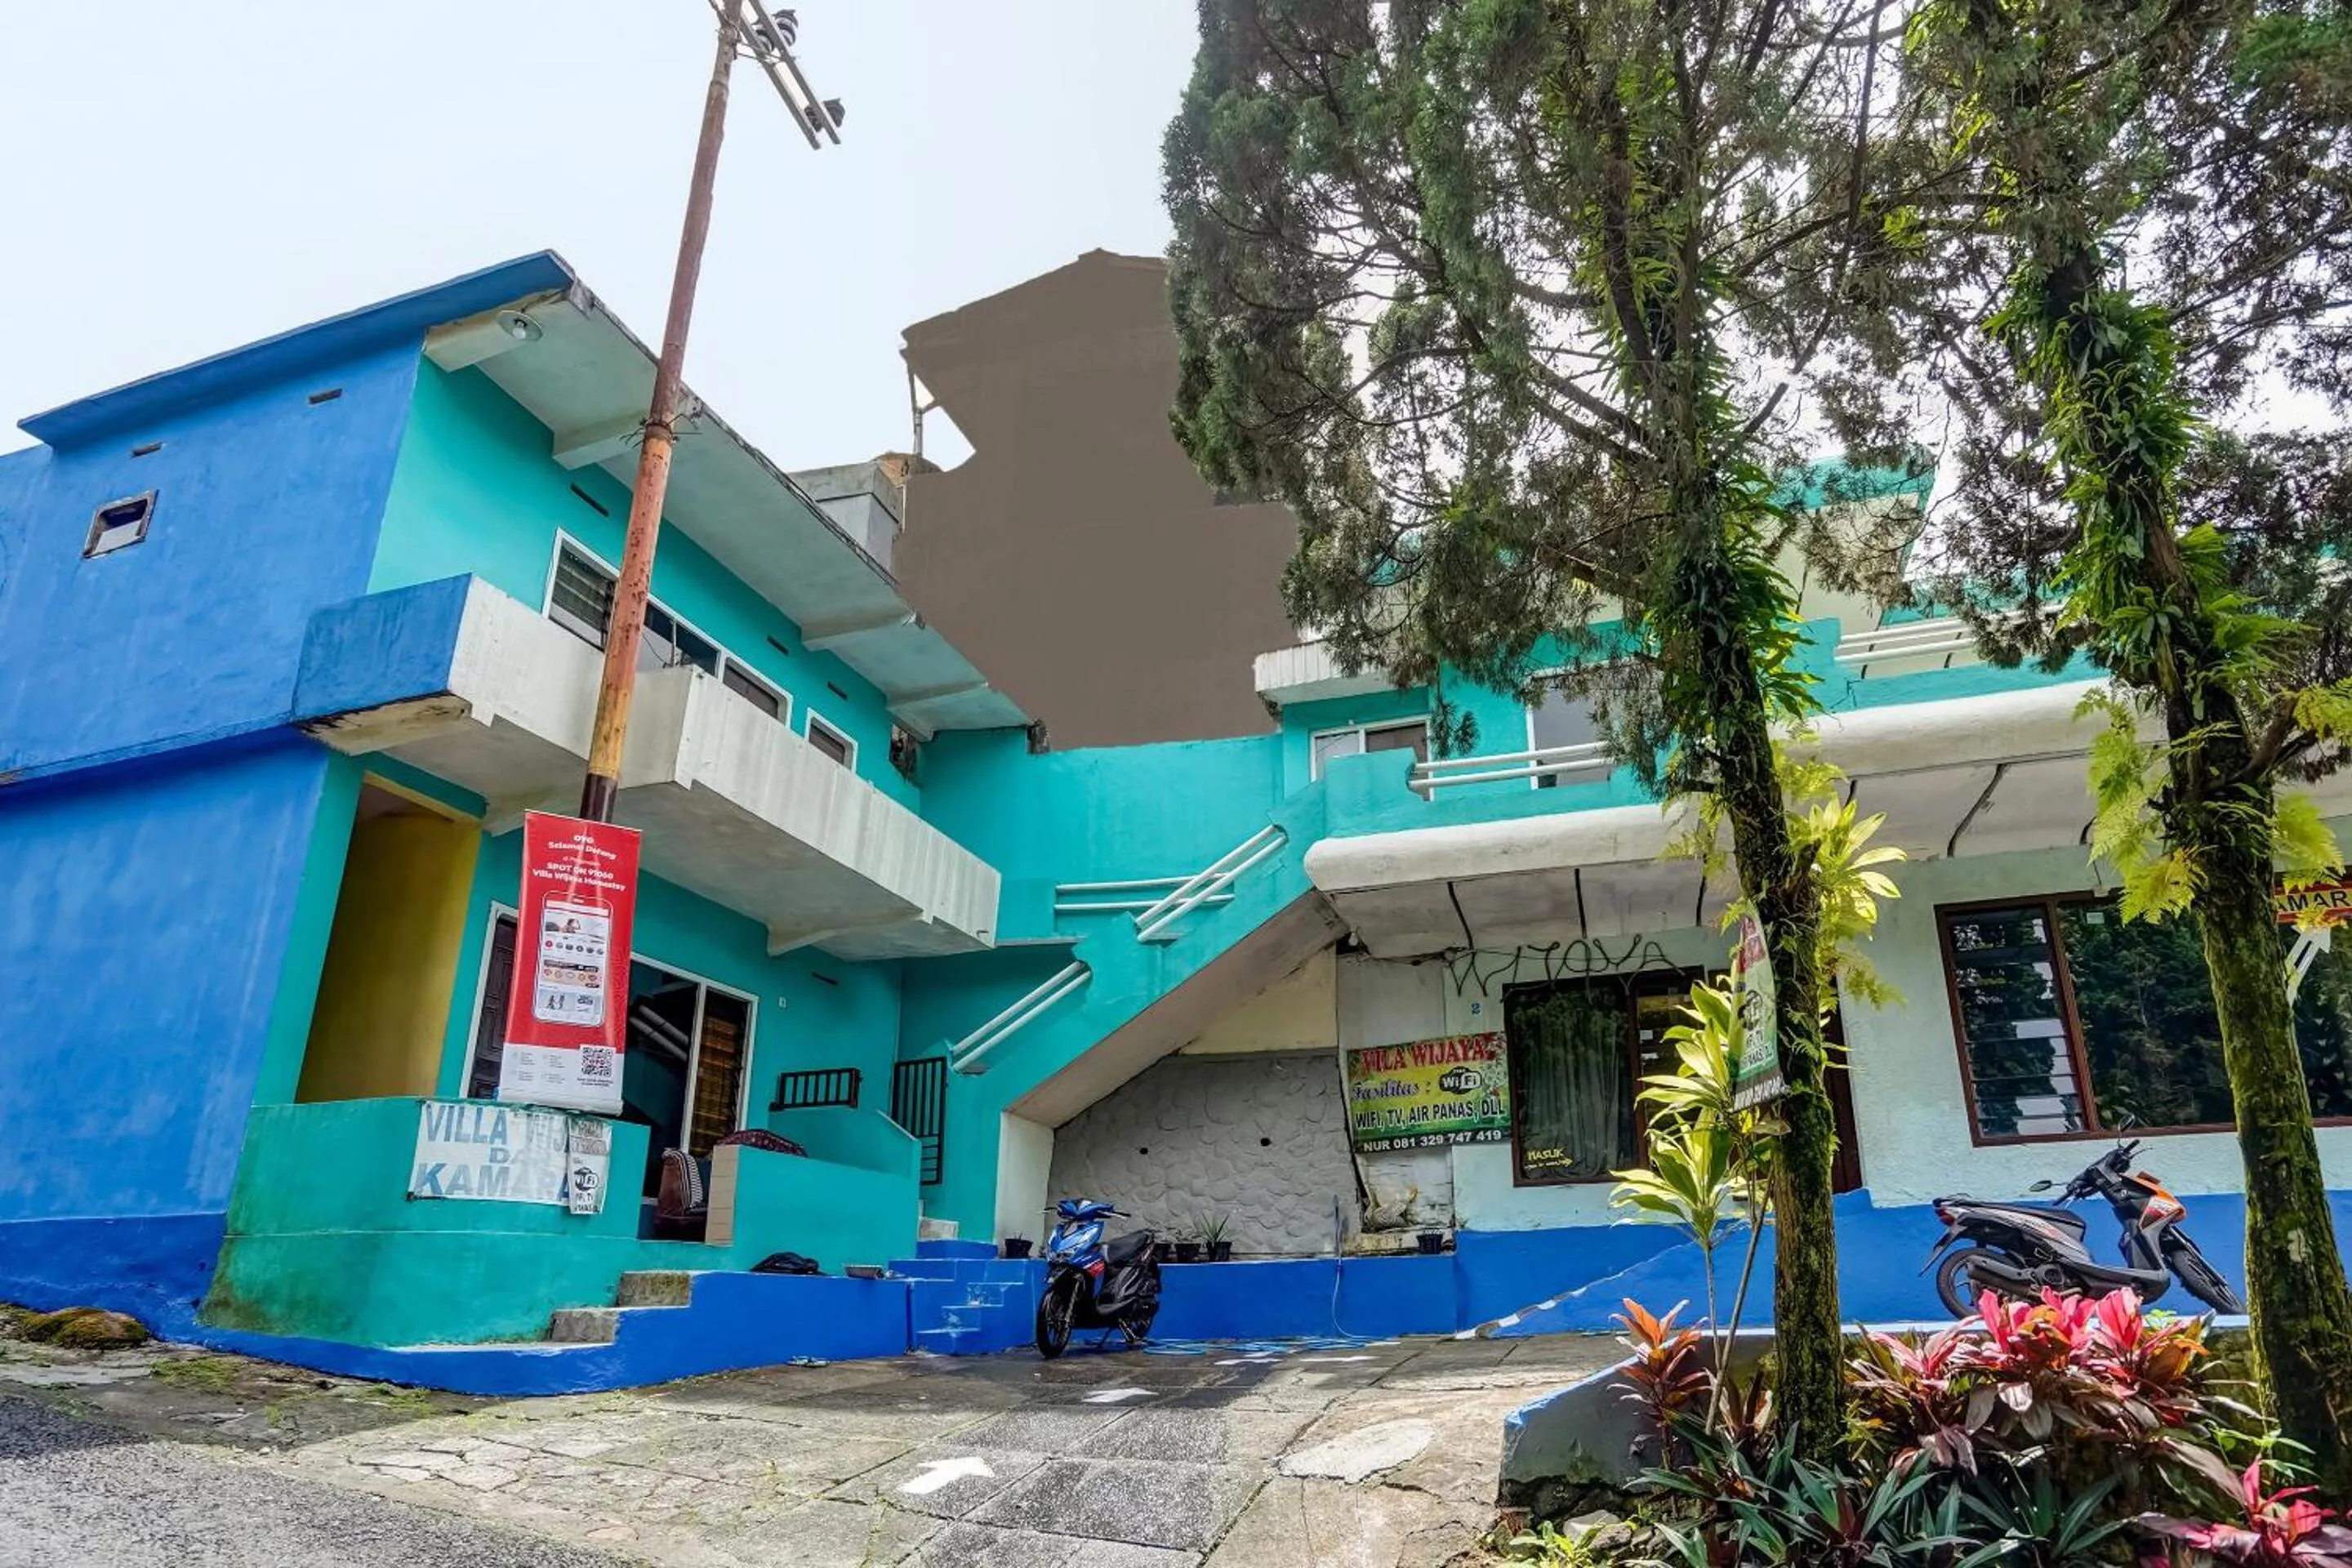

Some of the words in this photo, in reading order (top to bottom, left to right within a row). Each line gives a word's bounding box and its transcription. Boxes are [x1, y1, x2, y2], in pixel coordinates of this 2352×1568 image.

[546, 862, 572, 871] SPOT
[1407, 1037, 1486, 1067] WIJAYA
[1442, 1075, 1477, 1089] WiFi
[1409, 1104, 1429, 1123] AIR
[1432, 1101, 1479, 1124] PANAS,
[1481, 1098, 1505, 1118] DLL
[425, 1103, 508, 1146] VILLA
[1364, 1139, 1390, 1152] NUR
[1393, 1137, 1415, 1149] 081
[1420, 1134, 1444, 1147] 329
[1447, 1132, 1472, 1143] 747
